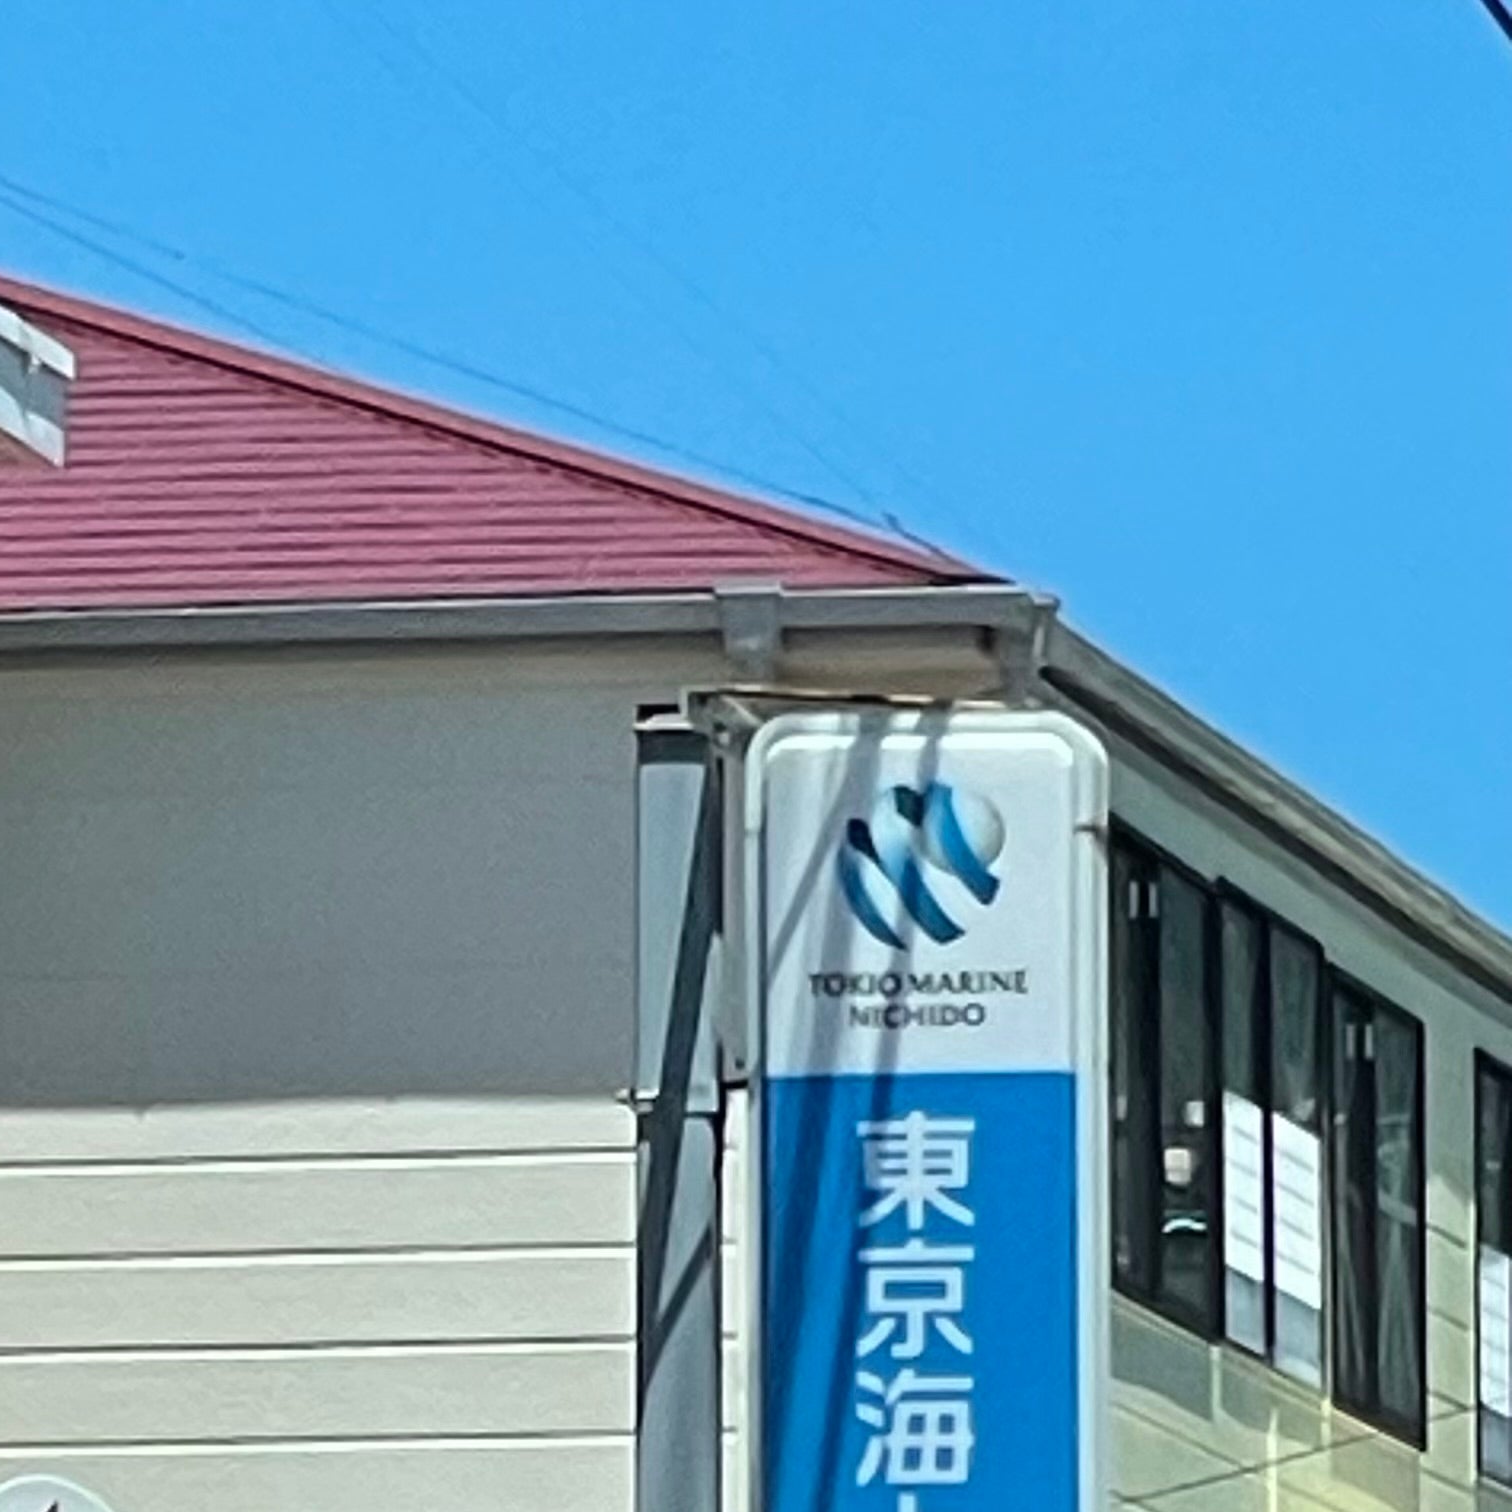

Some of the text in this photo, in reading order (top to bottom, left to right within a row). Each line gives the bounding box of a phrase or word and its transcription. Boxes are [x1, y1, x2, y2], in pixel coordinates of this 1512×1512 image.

[808, 969, 1029, 999] TOKIO MARINE
[849, 1002, 987, 1029] NICHIDO
